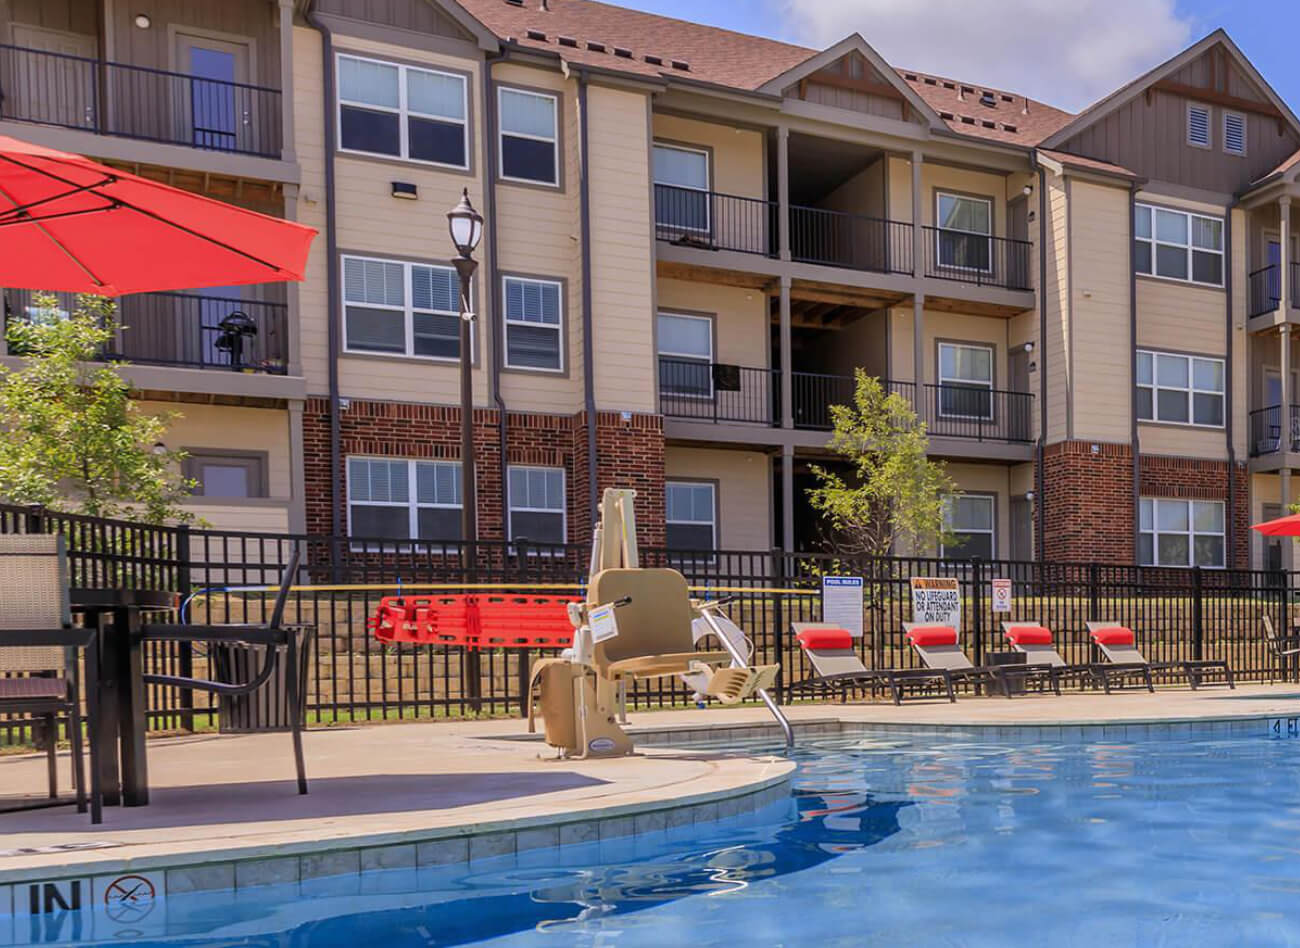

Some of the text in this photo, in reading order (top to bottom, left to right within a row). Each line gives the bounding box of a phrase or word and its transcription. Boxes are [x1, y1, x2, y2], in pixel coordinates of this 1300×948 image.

[927, 579, 956, 589] WARNING
[916, 591, 957, 601] NO LIFEGUARD
[916, 601, 959, 611] OR ATTENDANT
[925, 612, 950, 622] ON DUTY
[1273, 718, 1298, 733] 4 FT
[30, 880, 80, 914] IN
